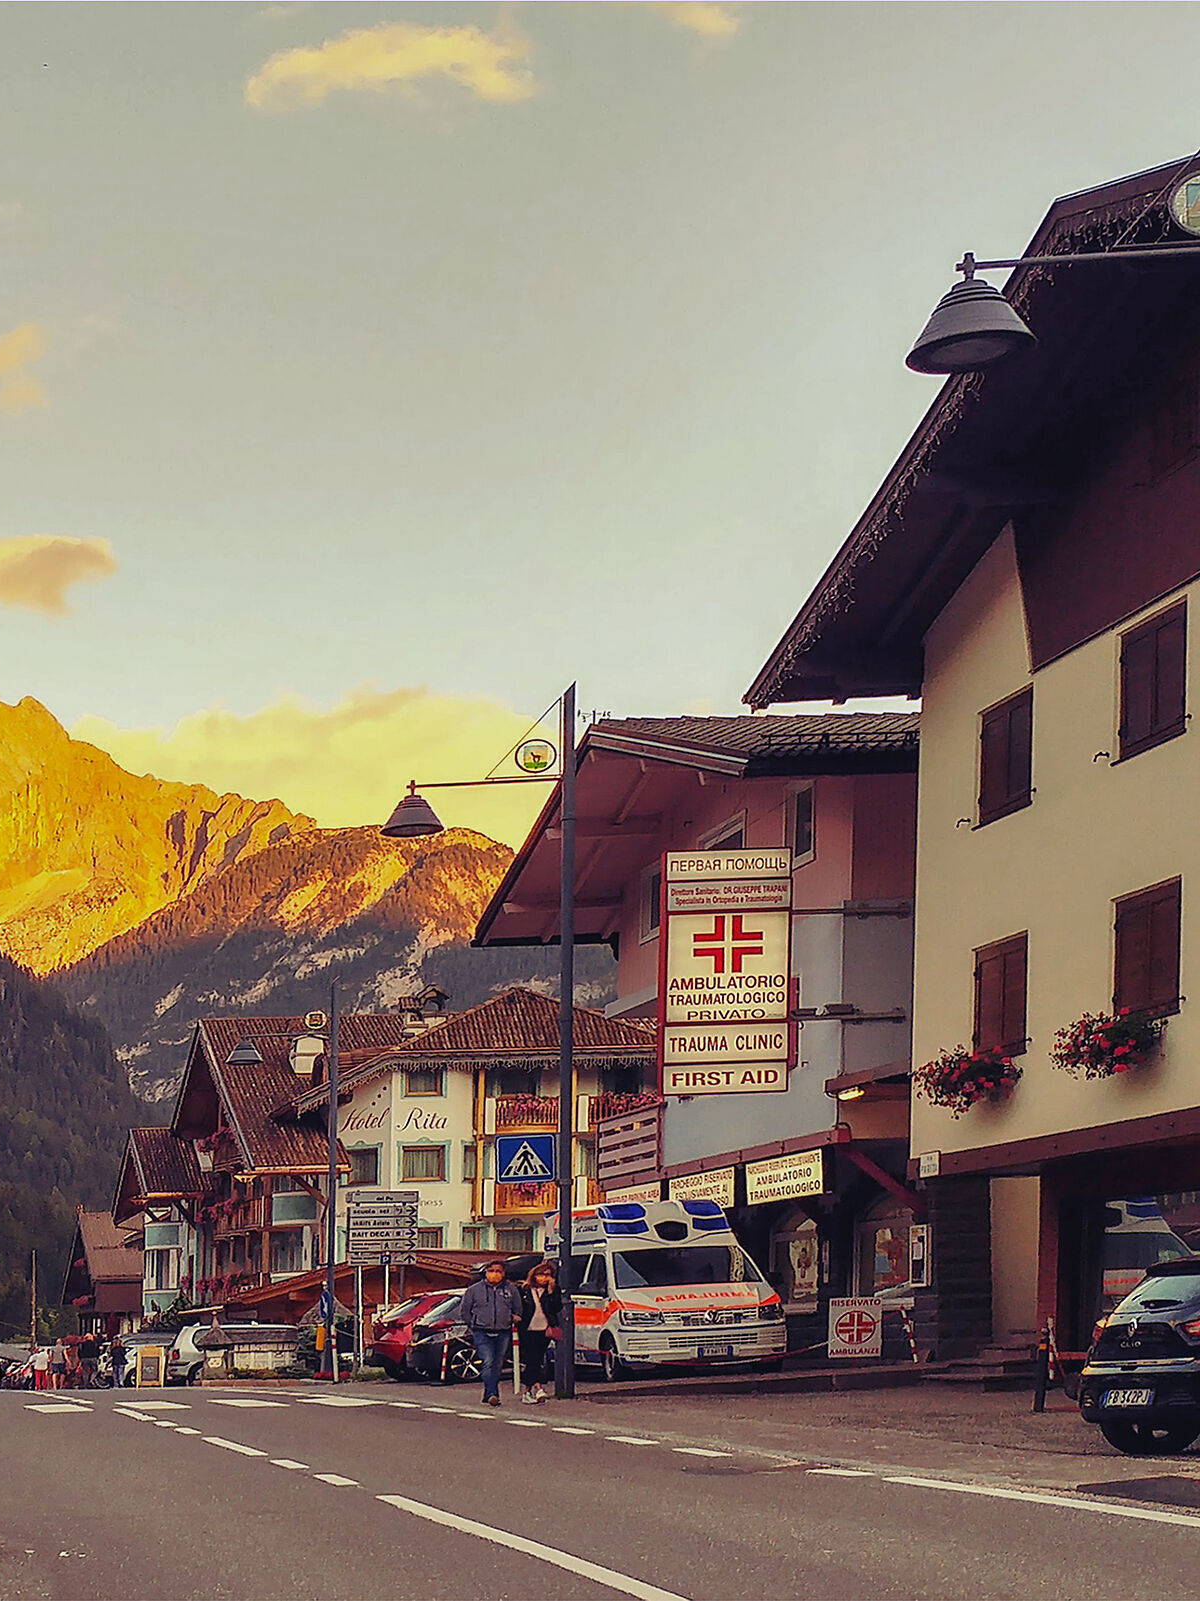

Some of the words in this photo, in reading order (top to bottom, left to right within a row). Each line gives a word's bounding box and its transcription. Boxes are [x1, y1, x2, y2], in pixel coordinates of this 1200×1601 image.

[671, 860, 721, 872] ПЕРВАЯ
[726, 858, 787, 871] ПОМОЩЬ
[713, 895, 739, 904] Ortopedia
[745, 894, 782, 903] Traumatologia
[669, 975, 785, 990] AMBULATORIO
[669, 991, 785, 1006] TRAUMATOLOGICO
[687, 1009, 766, 1020] PRIVATO
[669, 1036, 728, 1053] TRAUMA
[735, 1034, 783, 1050] CLINIC
[672, 1071, 734, 1086] FIRST
[740, 1070, 778, 1085] AID
[339, 1107, 390, 1133] Hotel
[397, 1106, 448, 1131] Rita
[756, 1167, 812, 1186] AMBULATORIO
[749, 1179, 821, 1201] TRAUMATOLOGICO
[831, 1298, 882, 1307] RISERVATO
[830, 1347, 879, 1356] AMBULANZE
